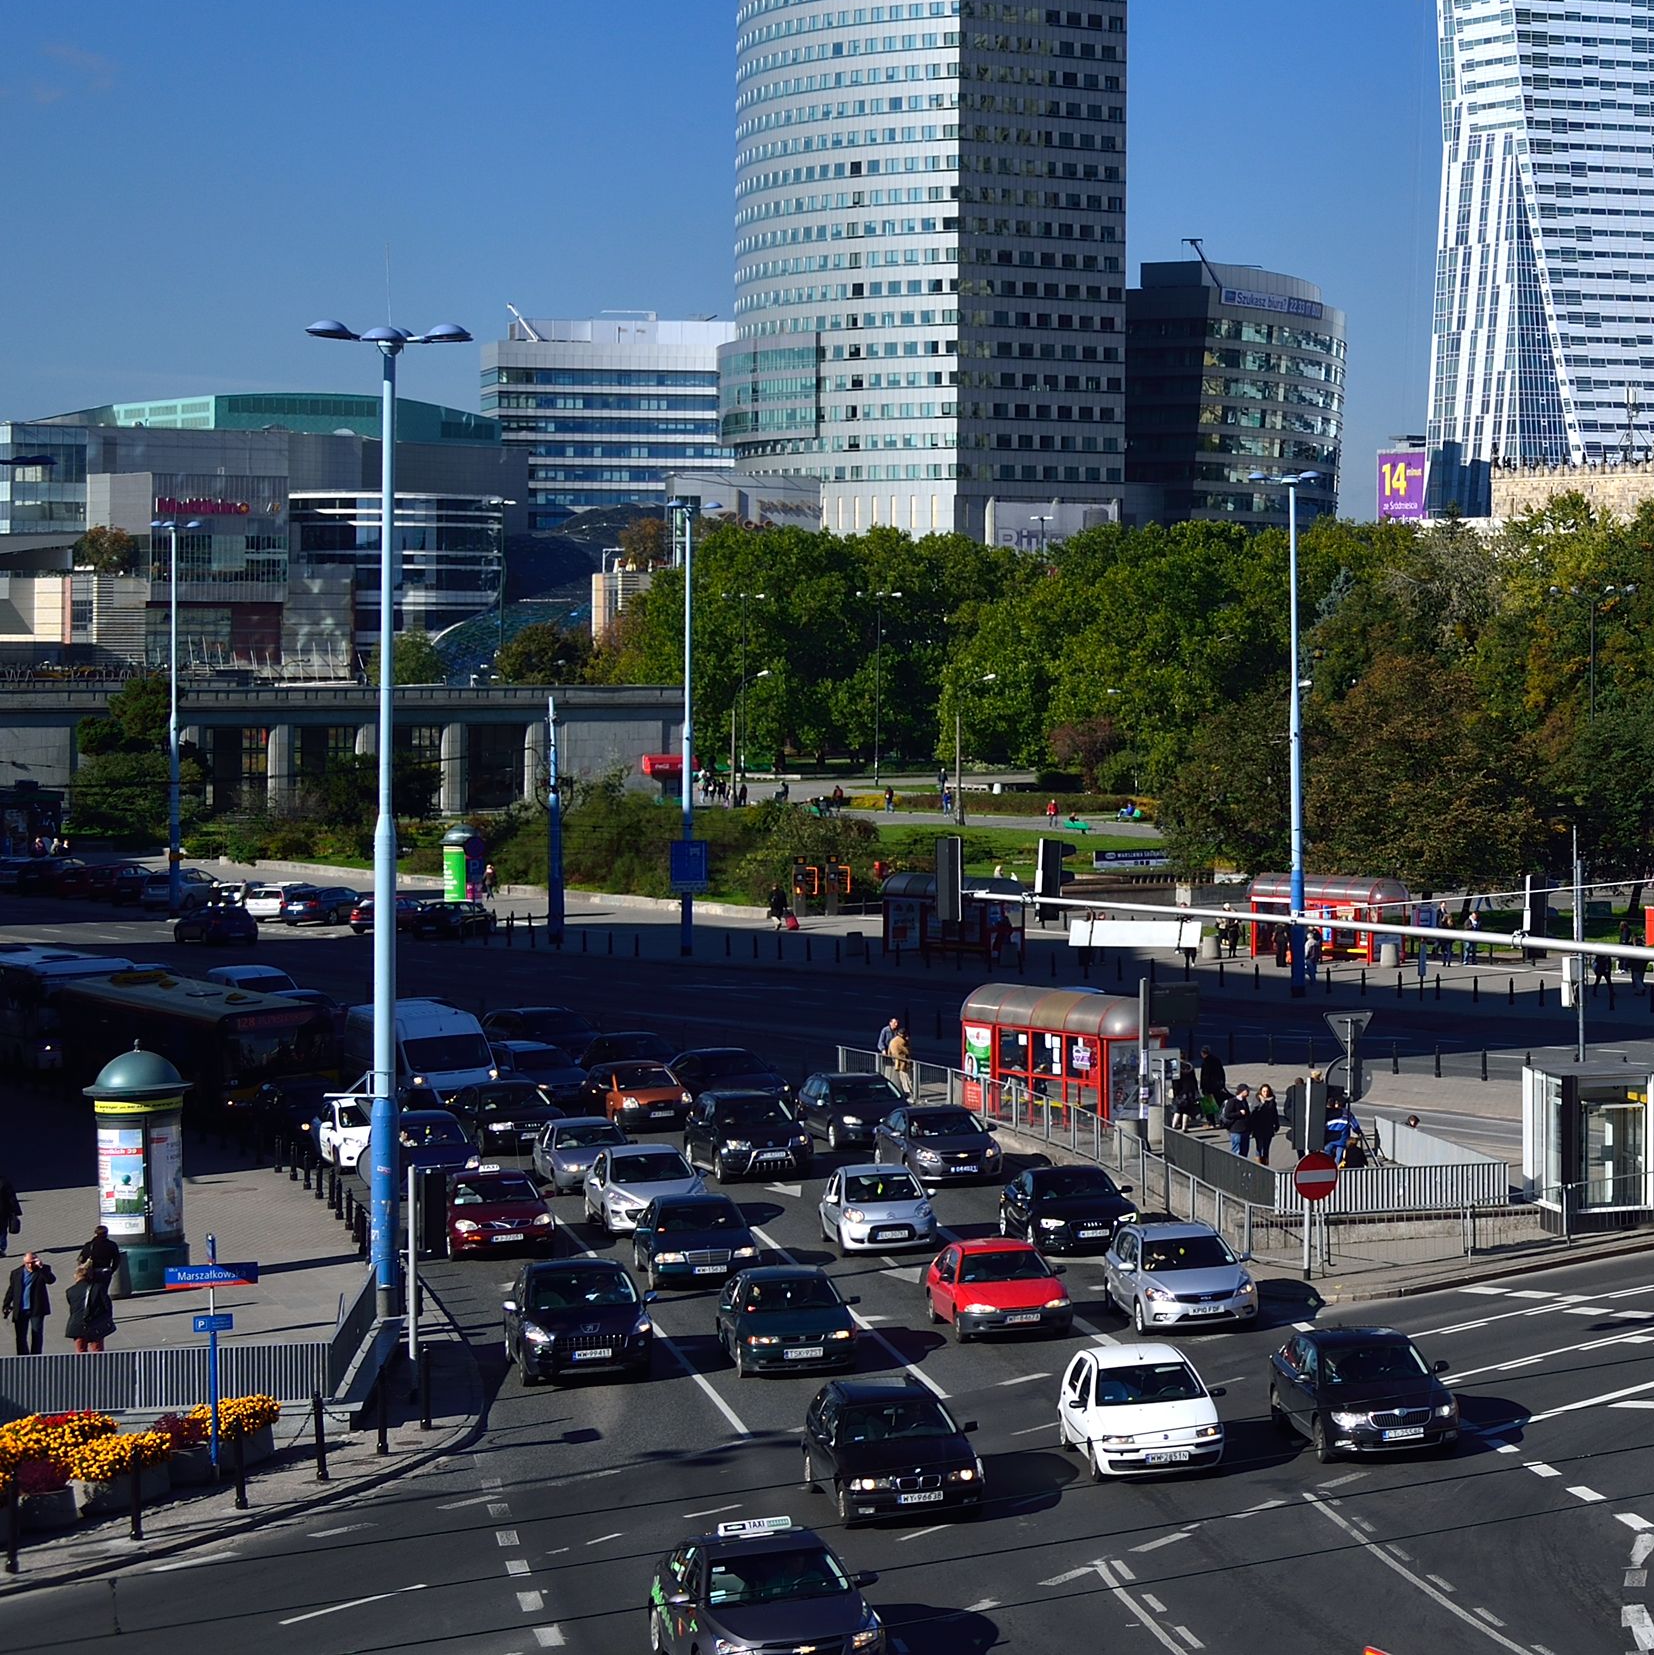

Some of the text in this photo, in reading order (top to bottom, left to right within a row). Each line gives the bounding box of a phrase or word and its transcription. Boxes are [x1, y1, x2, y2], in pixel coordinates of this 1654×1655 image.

[1237, 291, 1266, 307] Szukasz
[1382, 462, 1407, 496] 14
[749, 1520, 765, 1529] TAXI
